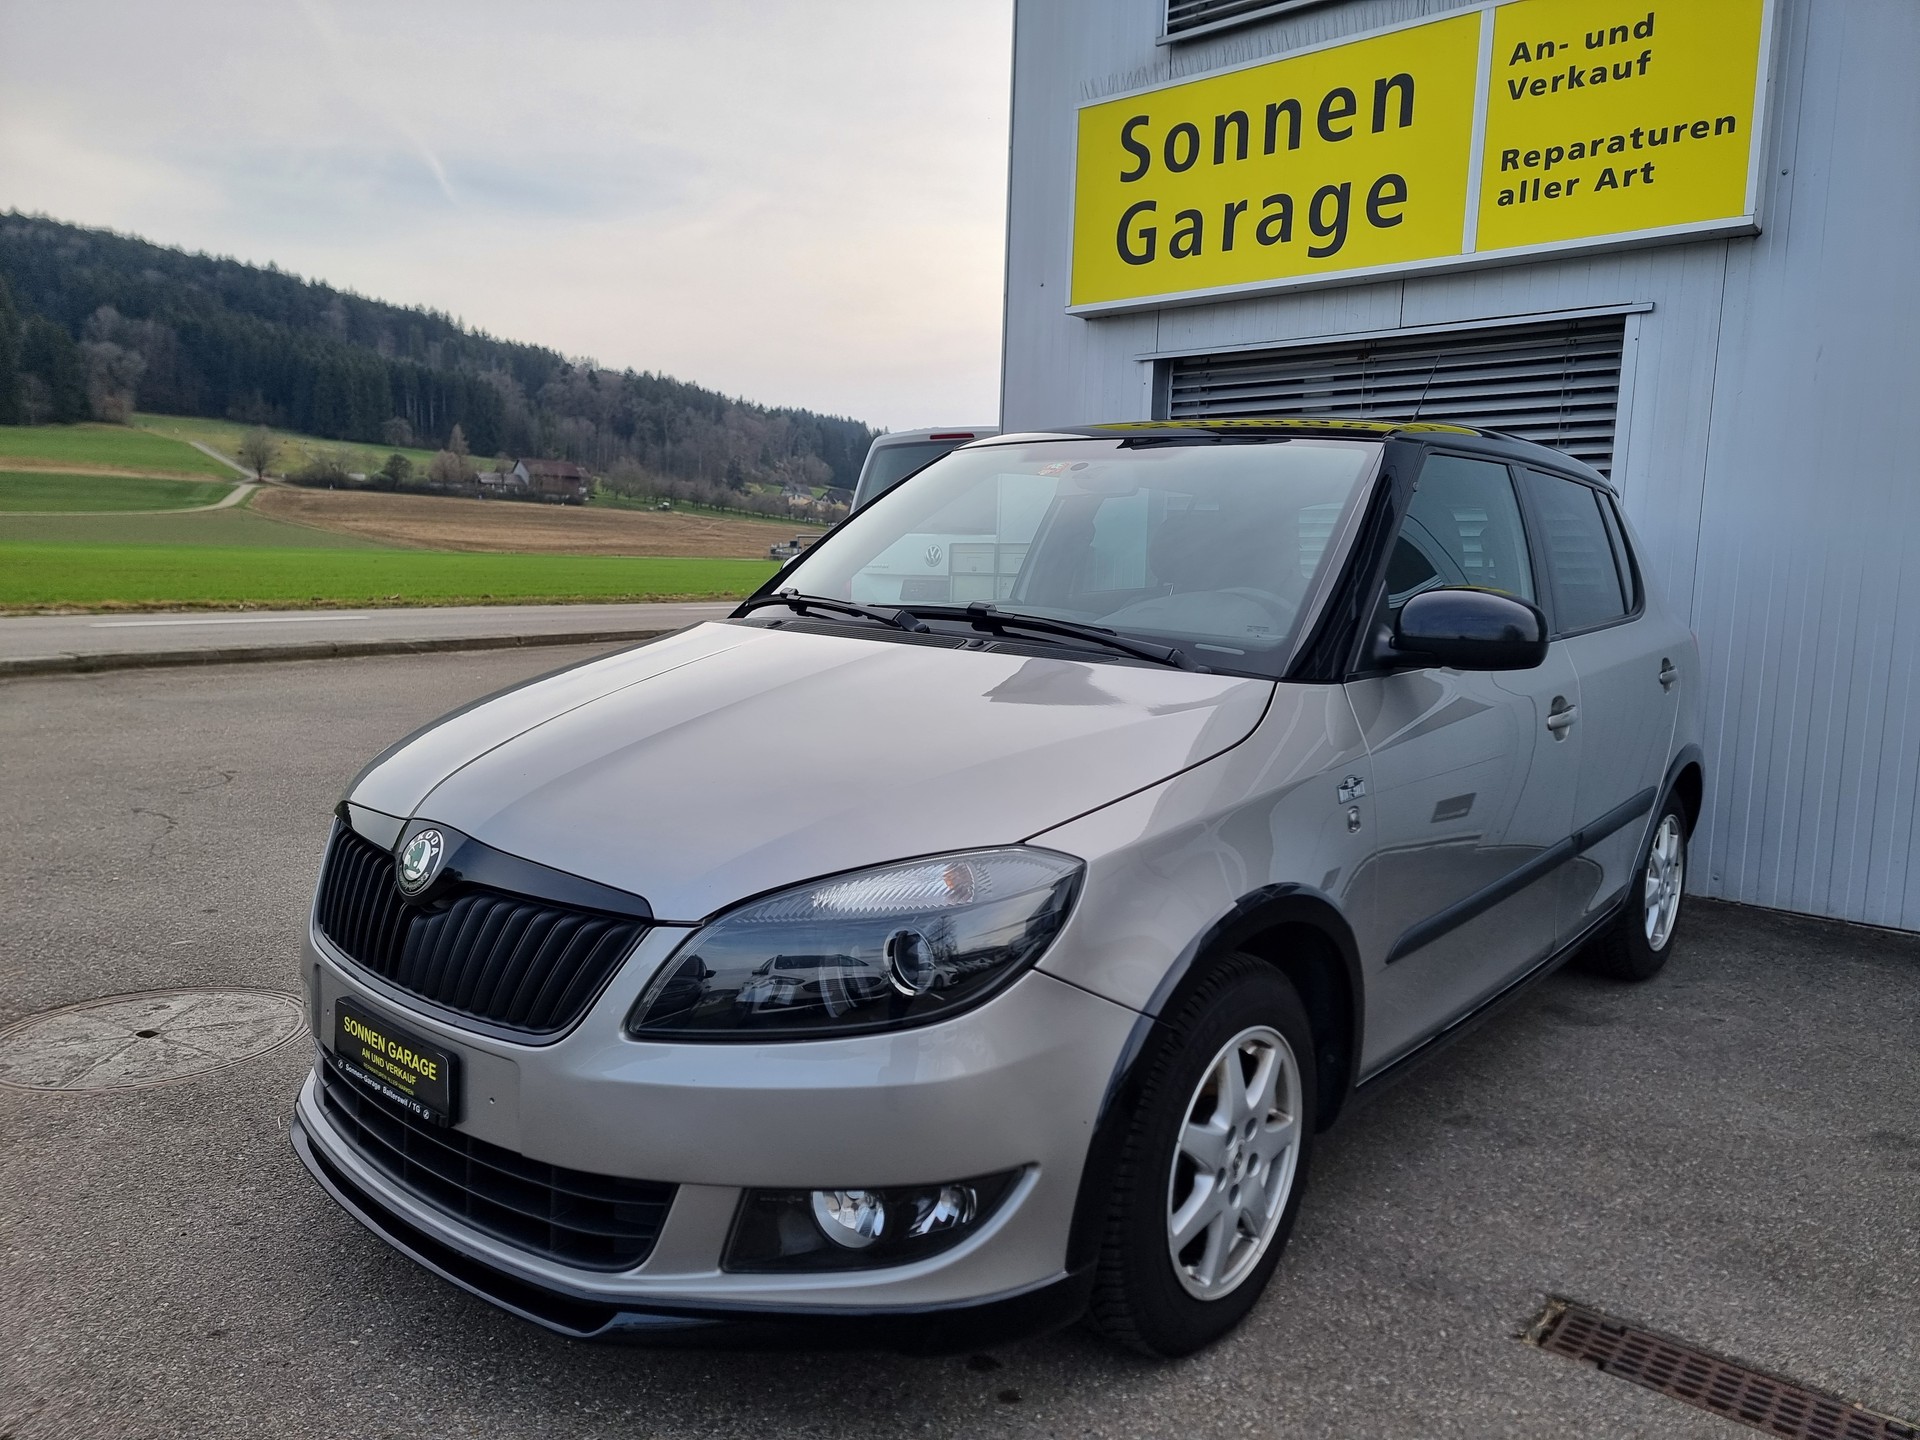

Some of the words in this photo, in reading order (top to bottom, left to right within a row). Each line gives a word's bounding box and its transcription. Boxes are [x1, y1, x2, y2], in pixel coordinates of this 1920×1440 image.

[1508, 41, 1569, 66] An-
[1585, 12, 1655, 50] und
[1508, 50, 1653, 101] Verkauf
[1120, 73, 1414, 182] Sonnen
[1501, 115, 1736, 173] Reparaturen
[1497, 177, 1581, 207] aller
[1593, 161, 1655, 192] Art
[1117, 174, 1407, 265] Garage
[344, 1016, 386, 1053] SONNEN
[387, 1041, 438, 1081] GARAGE
[362, 1048, 371, 1060] AN
[372, 1055, 385, 1068] UND
[385, 1060, 417, 1085] VERKAUF
[345, 1064, 381, 1090] Sonnen-Garage
[412, 1103, 421, 1113] TG
